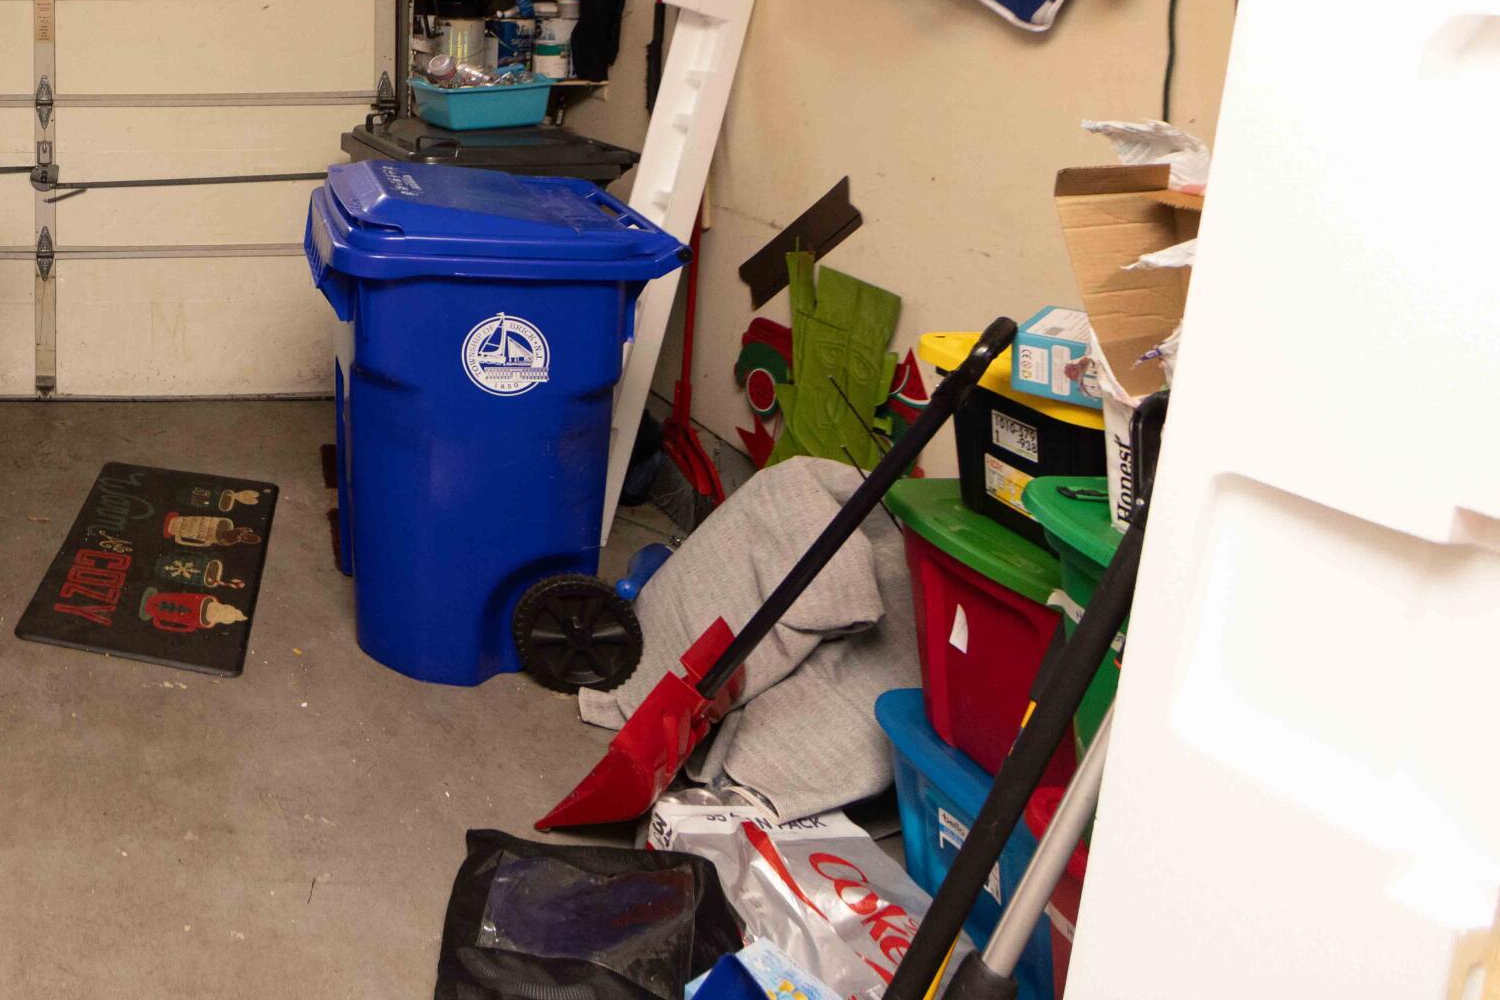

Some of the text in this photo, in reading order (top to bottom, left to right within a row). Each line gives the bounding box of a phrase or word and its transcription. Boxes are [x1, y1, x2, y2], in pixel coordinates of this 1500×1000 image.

[468, 332, 483, 378] TOWNSHIP
[482, 323, 494, 335] OF
[509, 322, 536, 342] BRICK
[1113, 435, 1134, 525] Honest
[53, 549, 132, 627] COZY
[808, 852, 912, 968] Coke
